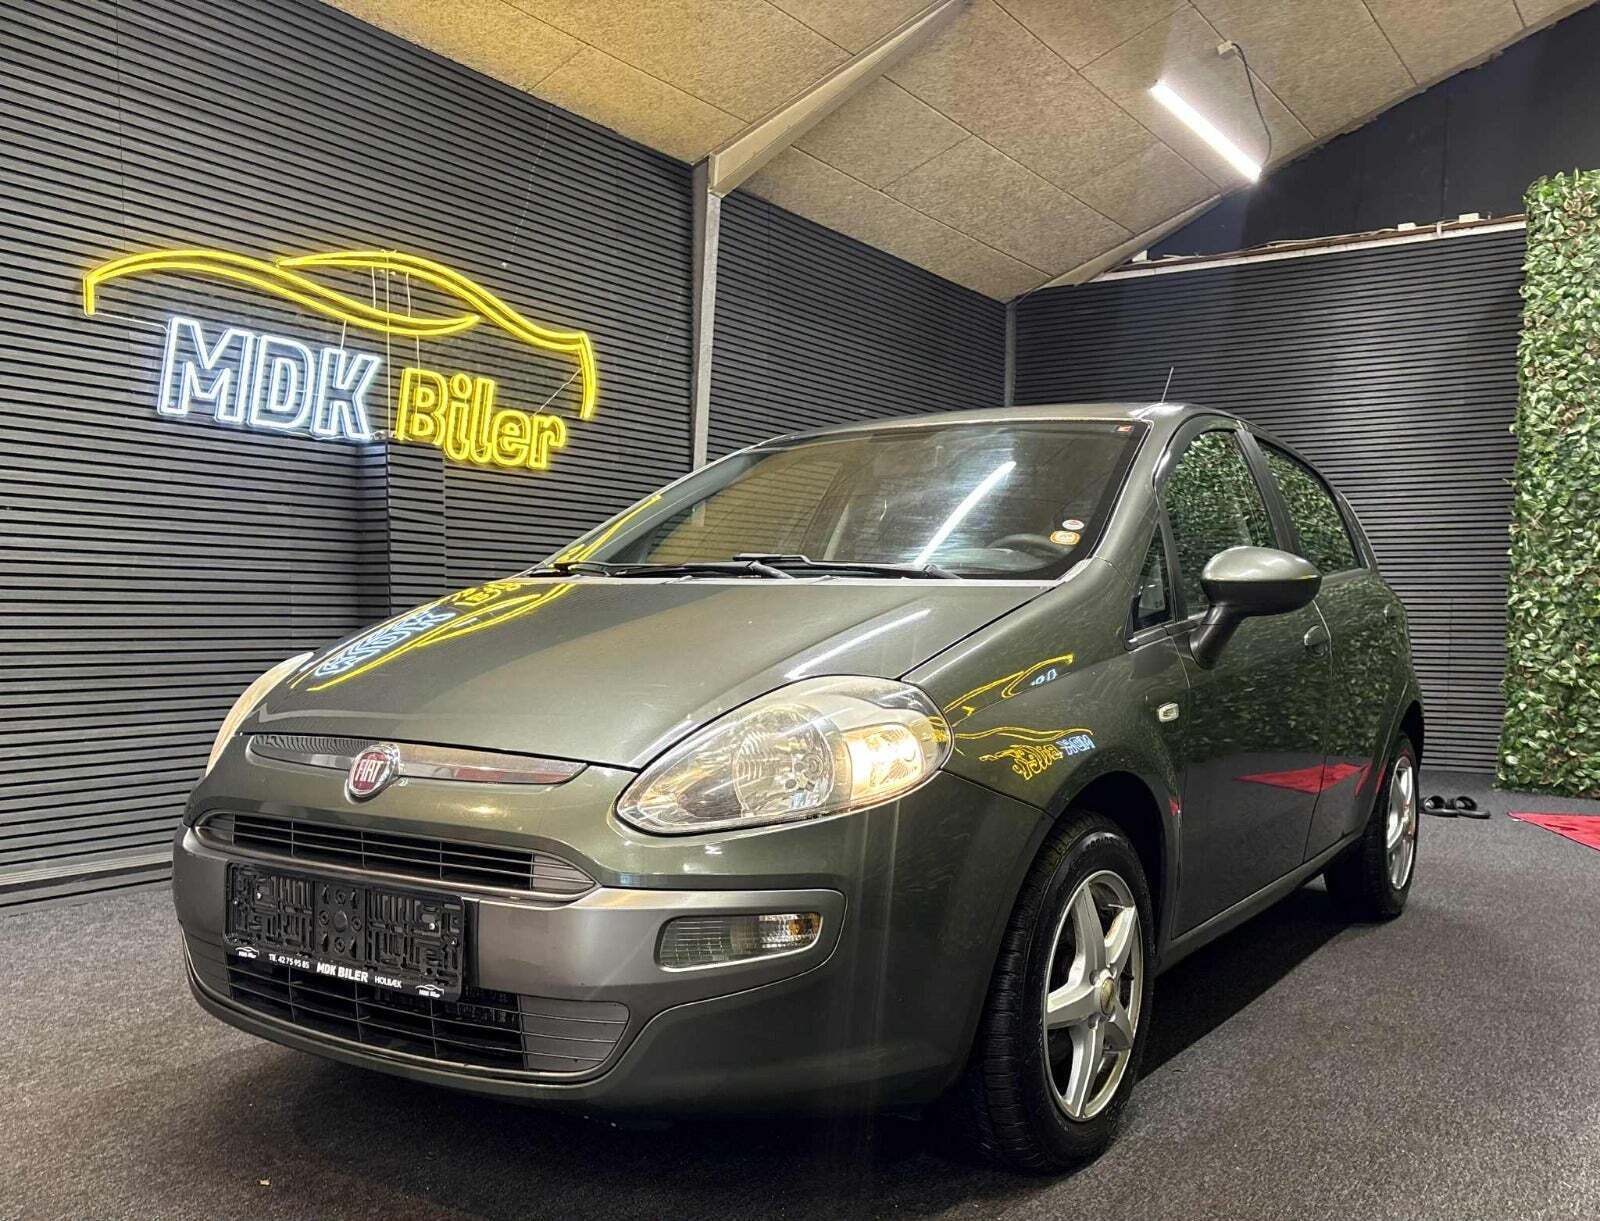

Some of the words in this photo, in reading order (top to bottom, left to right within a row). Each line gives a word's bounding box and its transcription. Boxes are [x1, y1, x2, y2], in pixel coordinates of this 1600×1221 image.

[157, 316, 380, 441] MDK
[395, 367, 567, 470] Biler
[354, 758, 385, 783] FIAT
[277, 955, 286, 964] 42
[286, 957, 294, 966] 75
[293, 958, 302, 968] 95
[301, 960, 310, 969] 85
[316, 961, 336, 976] MDK
[337, 966, 369, 983] BILER
